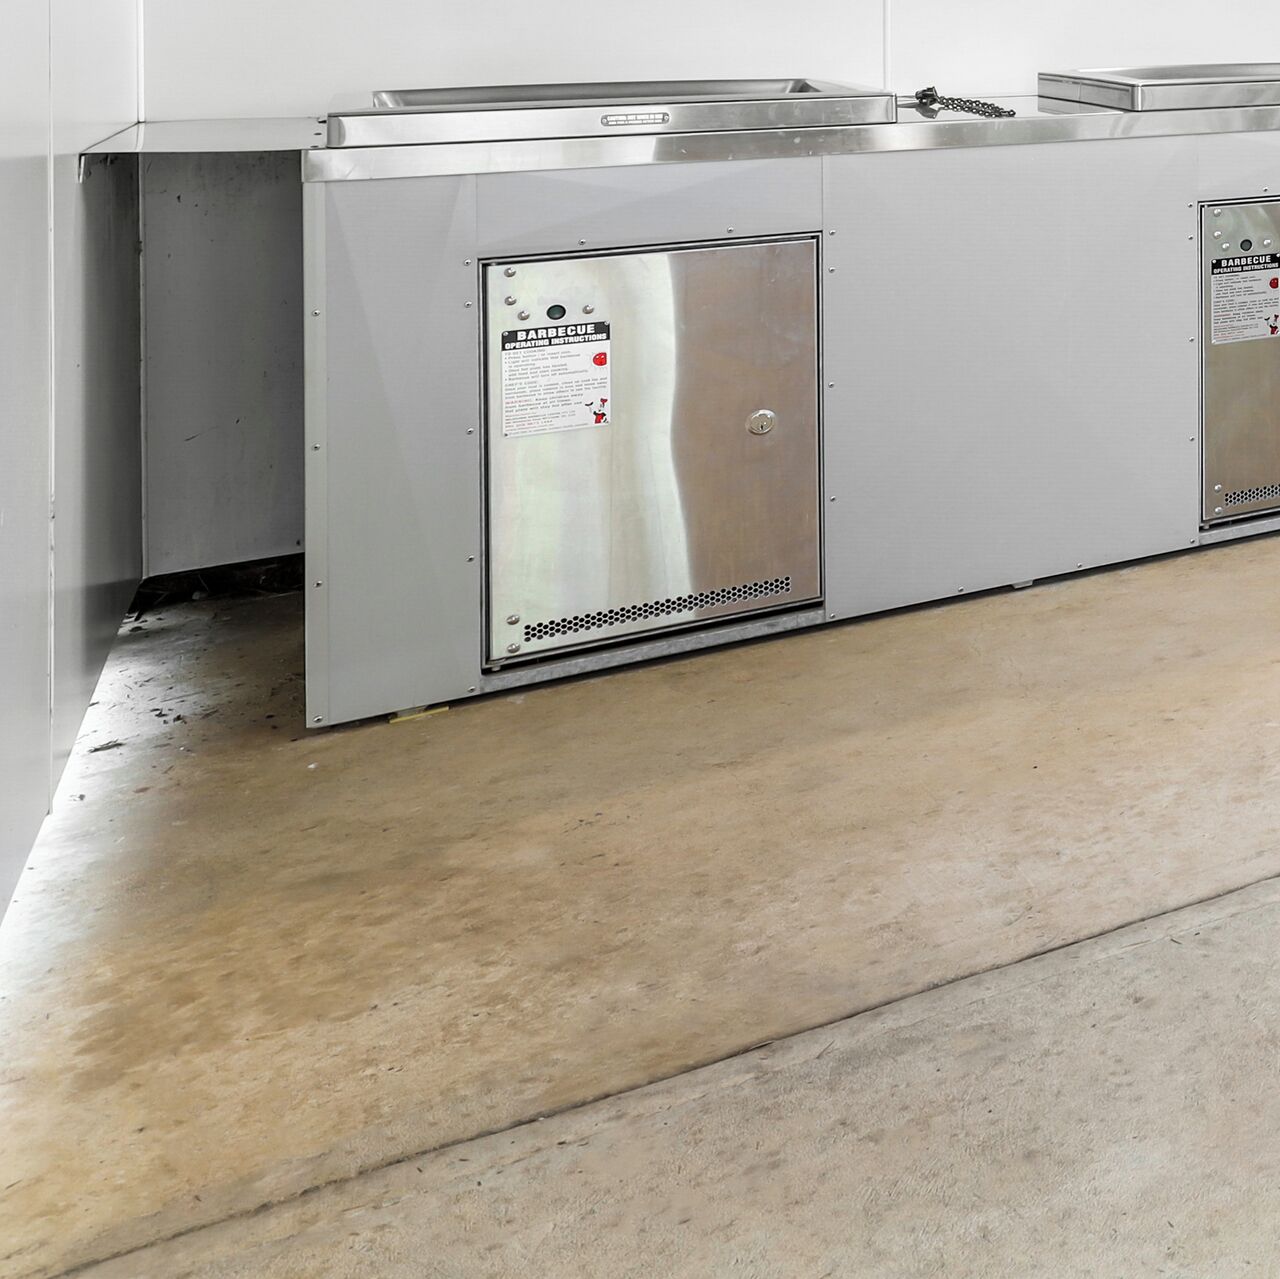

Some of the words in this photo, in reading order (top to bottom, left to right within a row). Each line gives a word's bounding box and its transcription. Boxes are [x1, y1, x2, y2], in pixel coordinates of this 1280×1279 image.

[1213, 266, 1242, 274] OPERATING
[1243, 262, 1279, 270] INSTRUCTIONS
[1221, 255, 1271, 267] BARBECUE
[517, 324, 595, 341] BARBECUE
[505, 339, 549, 350] OPERATING
[551, 333, 607, 345] INSTRUCTIONS
